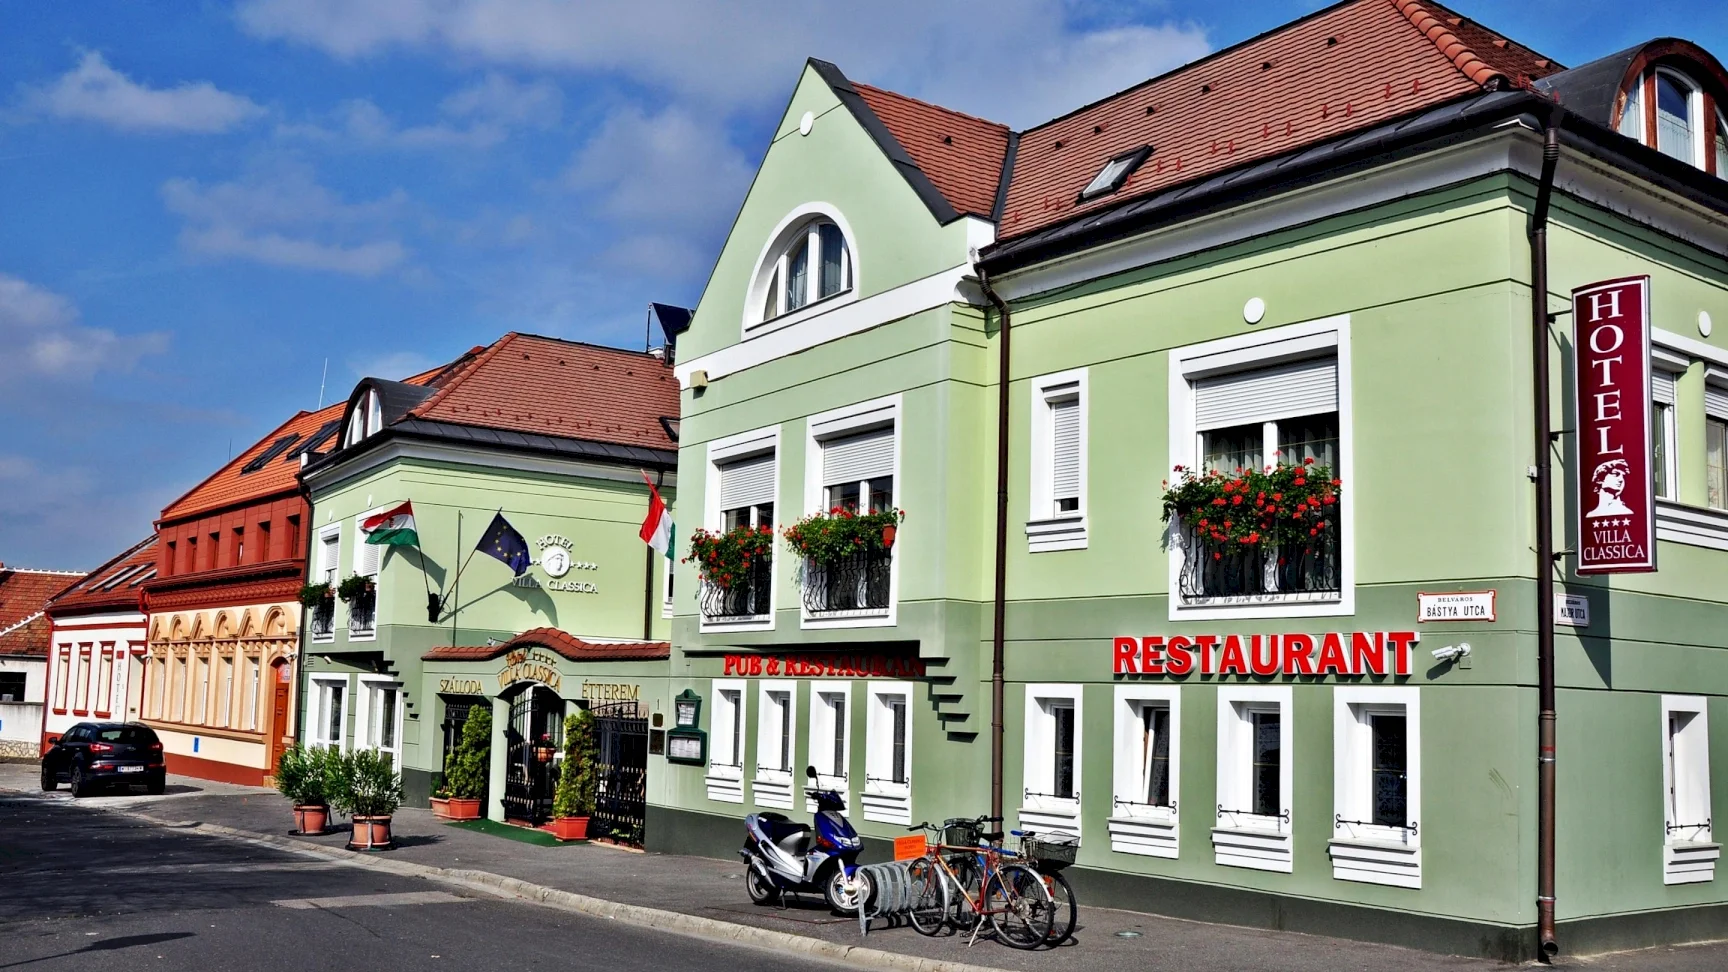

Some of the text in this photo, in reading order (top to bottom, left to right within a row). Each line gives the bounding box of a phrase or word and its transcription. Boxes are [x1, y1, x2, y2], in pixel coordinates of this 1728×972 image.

[1588, 289, 1624, 455] HOTEL
[536, 534, 574, 553] HOTEL
[1593, 529, 1632, 544] VILLA
[1583, 544, 1646, 561] CLASSICA
[510, 576, 599, 594] VILLA CLASSICA
[1426, 604, 1486, 617] BÁSTYA UTCA
[1112, 631, 1420, 677] RESTAURANT
[723, 654, 927, 677] PUB & RESTAURAN
[439, 675, 484, 695] SZÁLLODA
[497, 663, 561, 693] VILLA CLASSICA
[581, 678, 640, 701] ÉTTEREM
